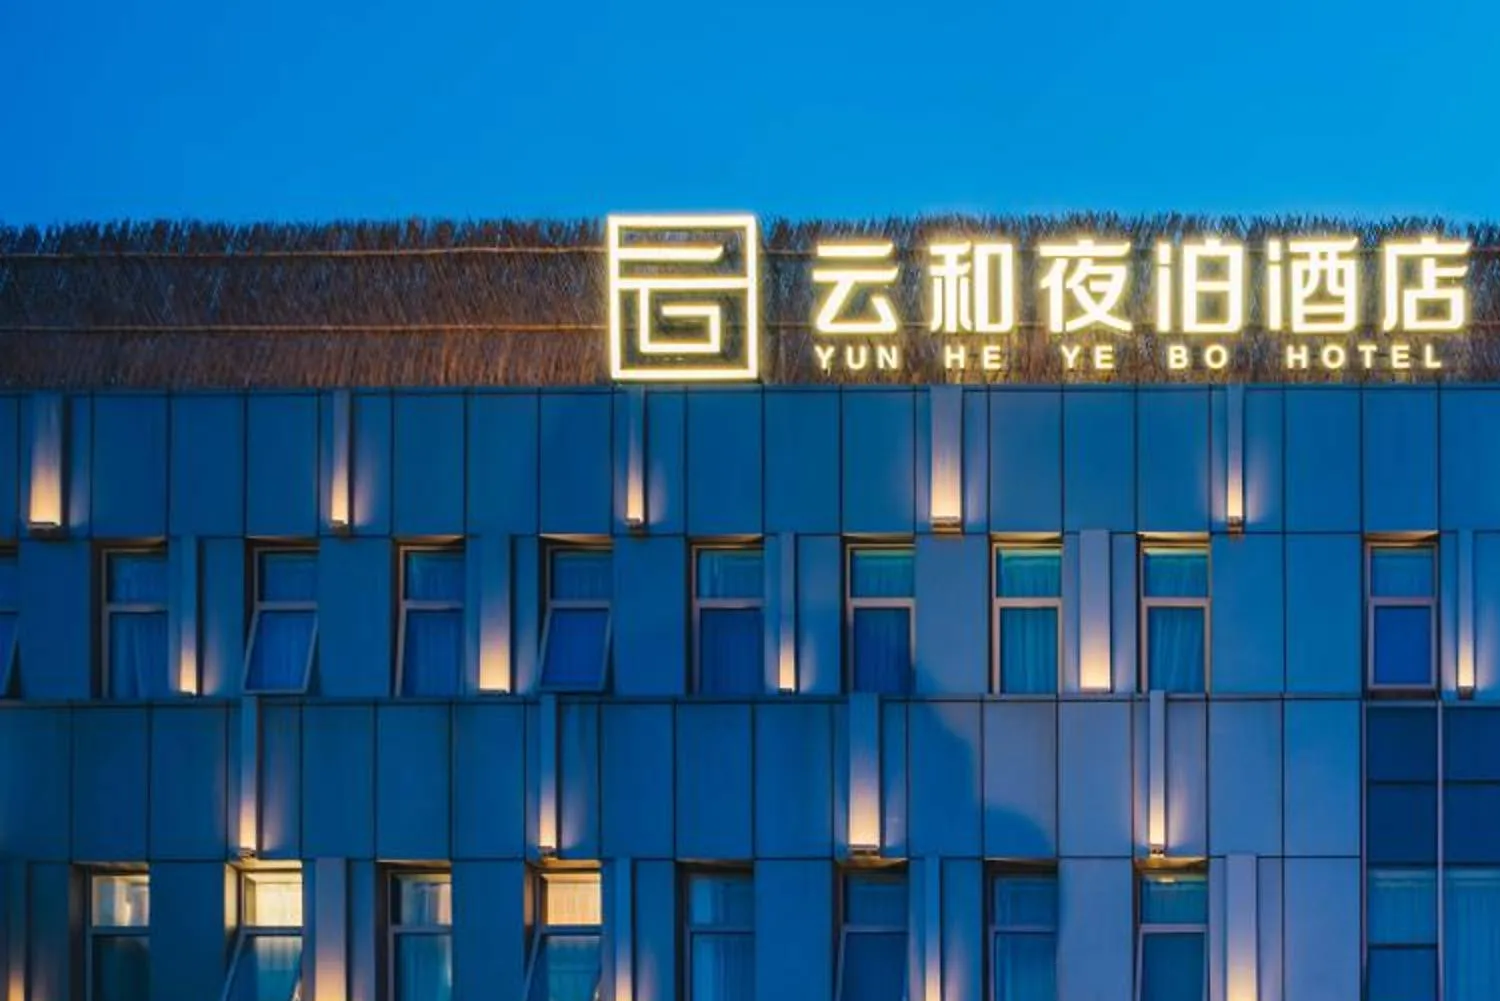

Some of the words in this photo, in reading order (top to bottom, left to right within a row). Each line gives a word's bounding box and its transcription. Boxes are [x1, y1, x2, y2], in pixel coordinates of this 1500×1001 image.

[812, 237, 1471, 333] 云和夜泊酒店
[814, 344, 898, 370] YUN
[944, 344, 1002, 370] HE
[1061, 345, 1115, 370] YE
[1167, 344, 1229, 370] BO
[1286, 344, 1442, 370] HOTEL
